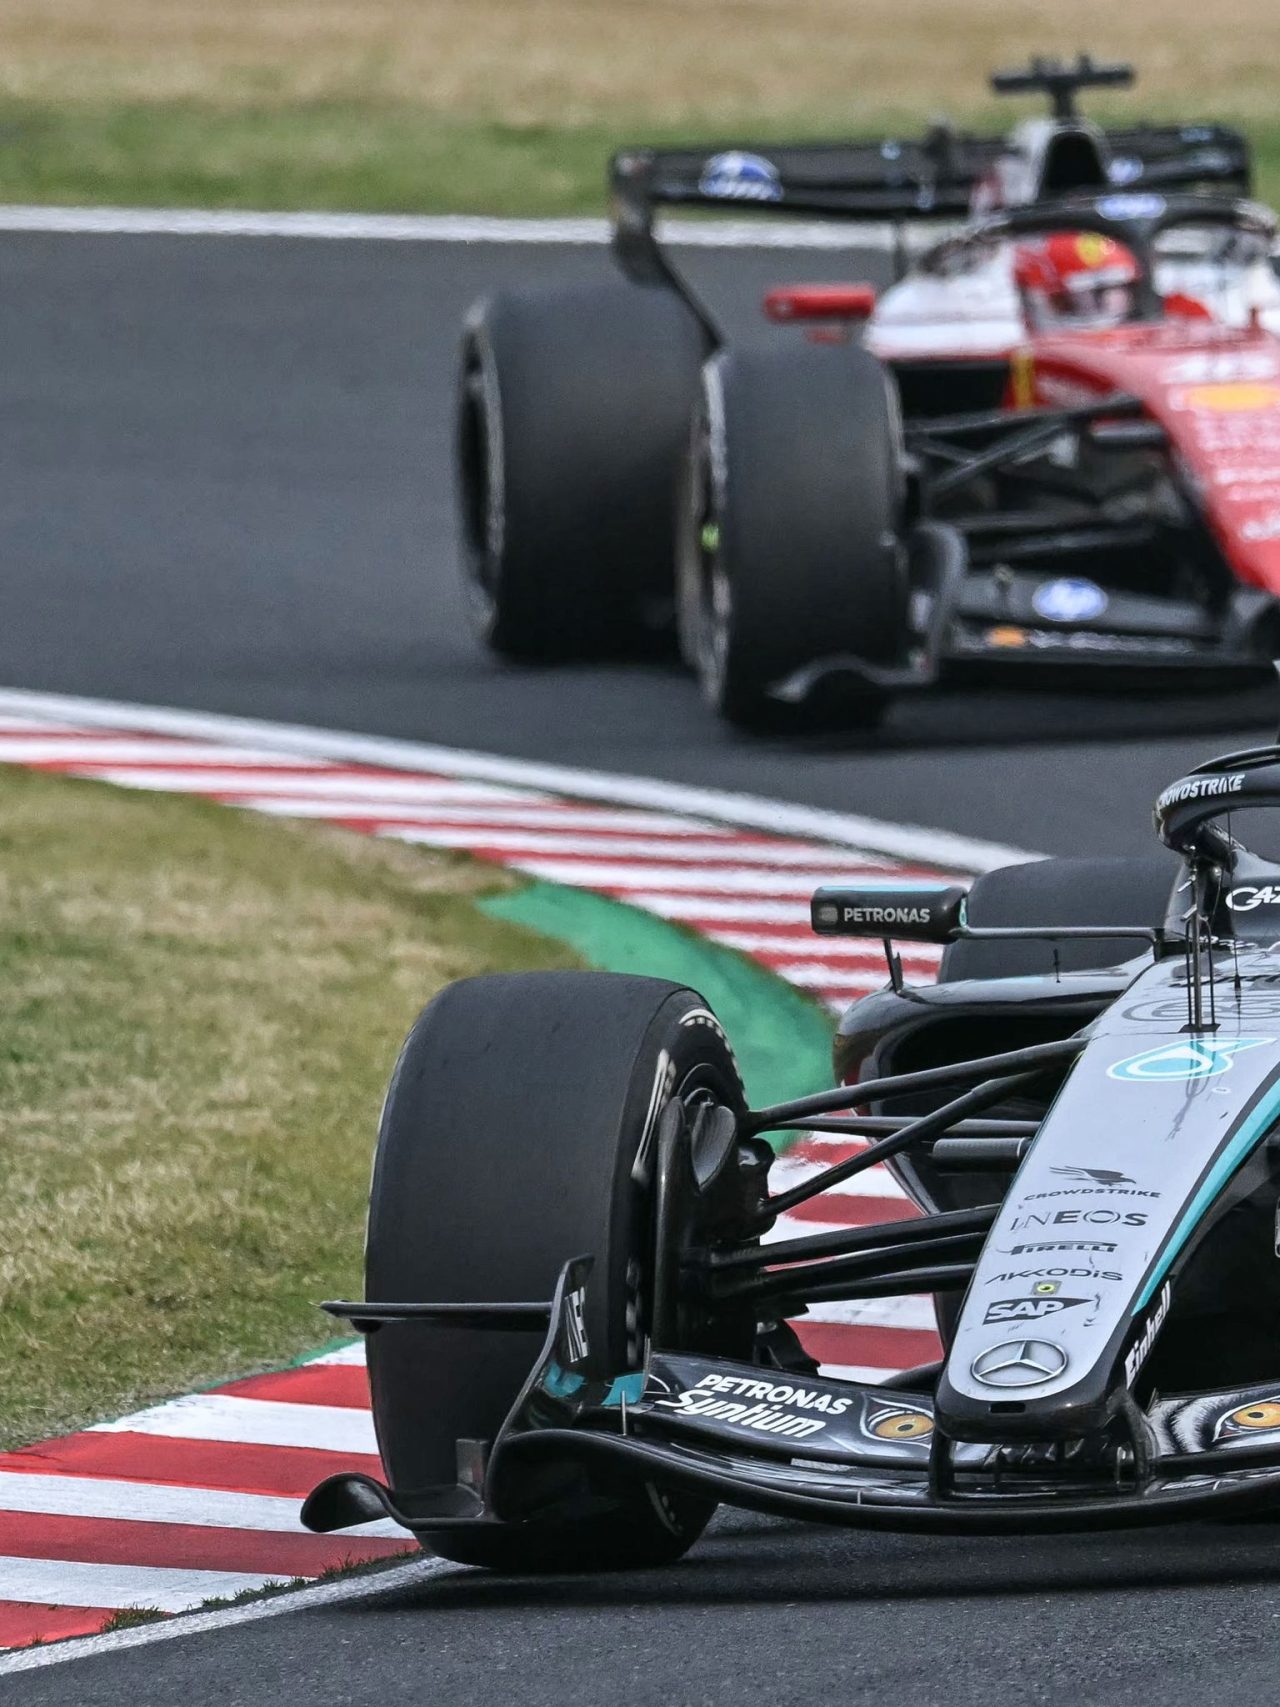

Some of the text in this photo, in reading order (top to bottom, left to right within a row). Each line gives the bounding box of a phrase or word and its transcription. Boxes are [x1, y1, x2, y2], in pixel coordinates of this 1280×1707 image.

[843, 907, 931, 923] PETRONAS
[1023, 1187, 1162, 1201] CROWDSTRIKE
[1010, 1209, 1149, 1232] INEOS
[1009, 1240, 1119, 1256] PIRELLI
[985, 1300, 1065, 1321] SAP
[1124, 1279, 1171, 1391] Einhell
[694, 1373, 854, 1415] PETRONAS
[654, 1389, 827, 1438] Syntium
